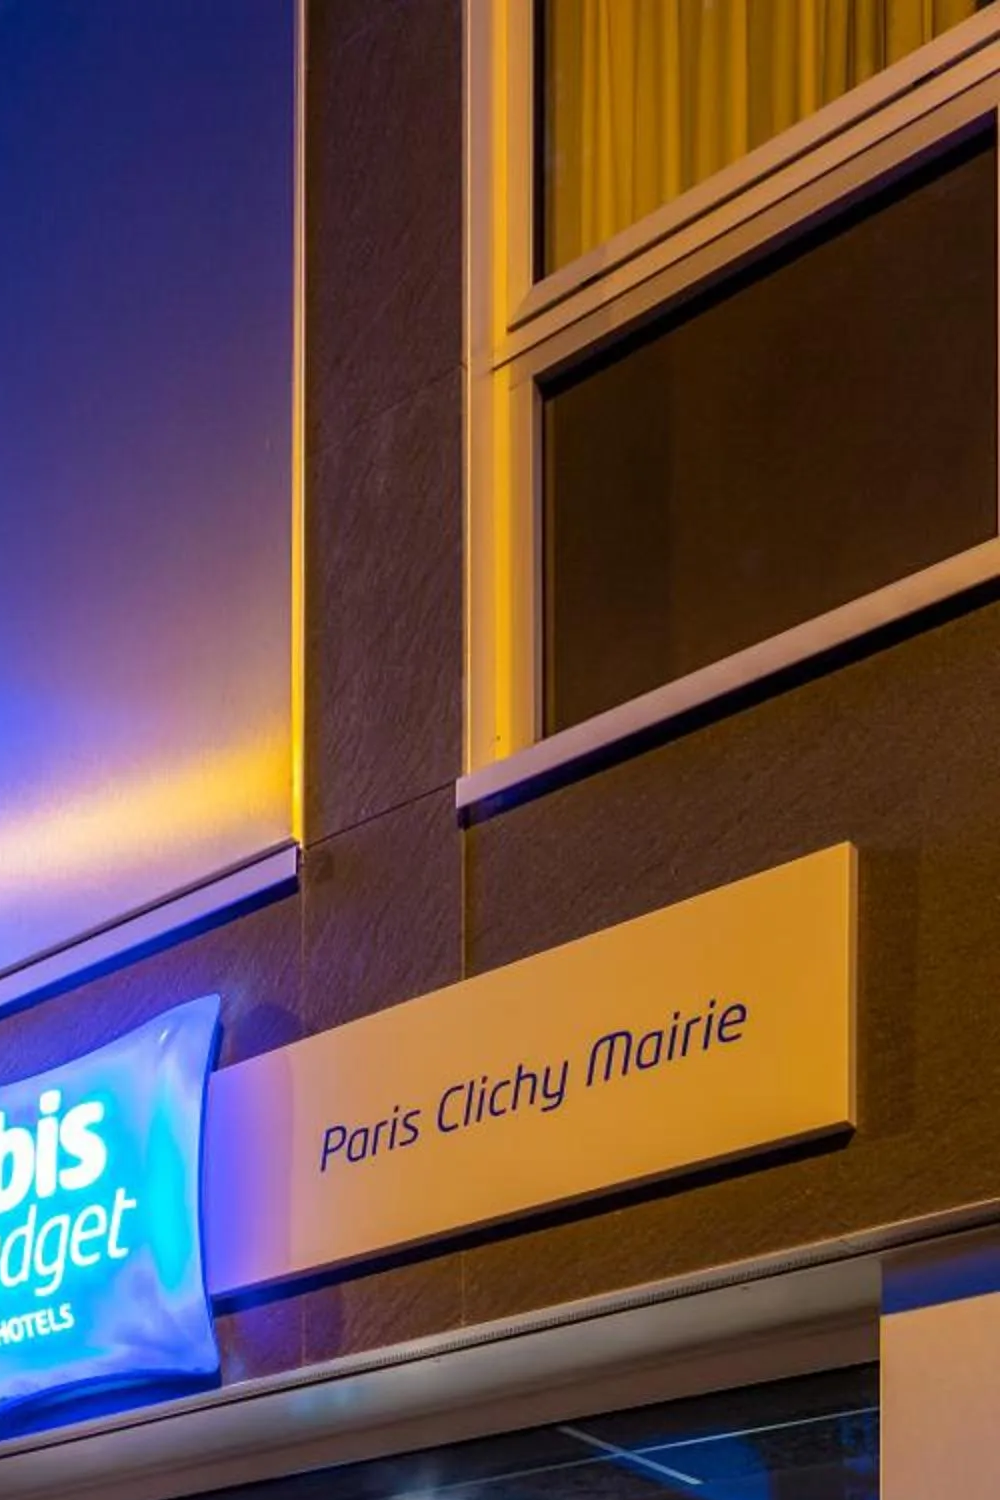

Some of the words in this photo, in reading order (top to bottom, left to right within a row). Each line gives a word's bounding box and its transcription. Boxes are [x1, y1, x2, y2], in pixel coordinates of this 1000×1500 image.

[320, 1105, 421, 1172] Paris
[436, 1060, 569, 1134] Clichy
[586, 1000, 747, 1086] Mairie
